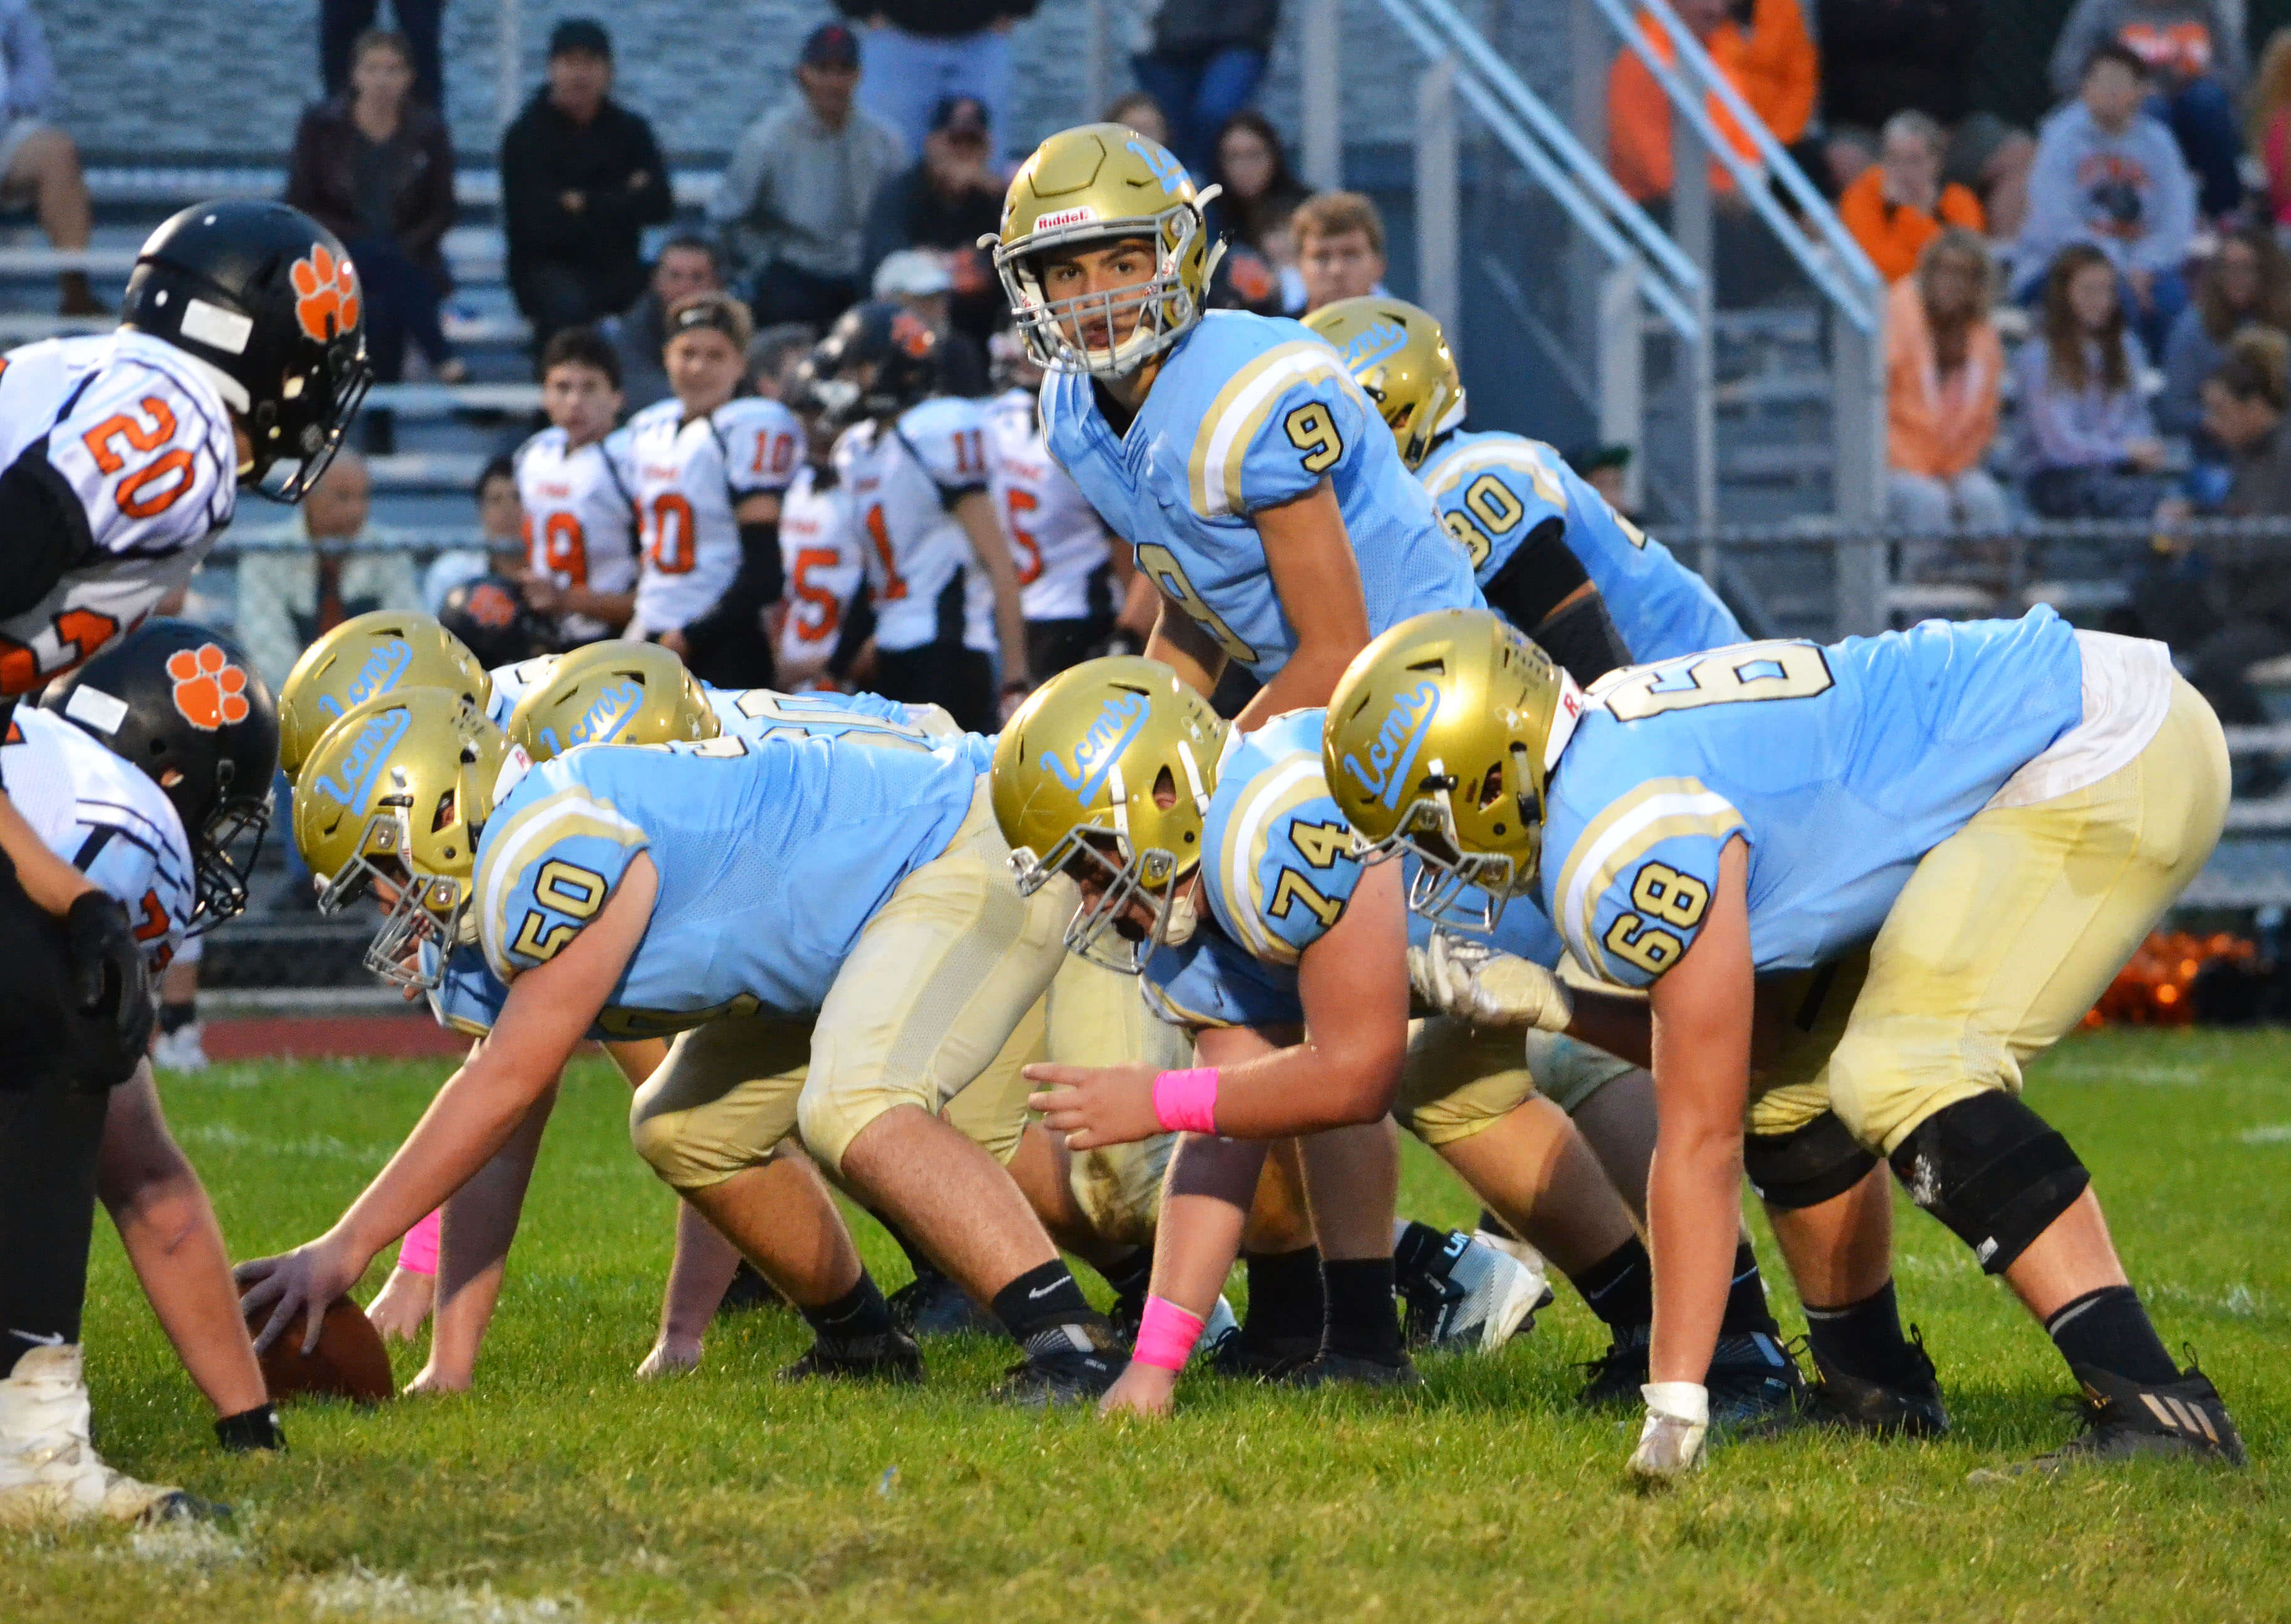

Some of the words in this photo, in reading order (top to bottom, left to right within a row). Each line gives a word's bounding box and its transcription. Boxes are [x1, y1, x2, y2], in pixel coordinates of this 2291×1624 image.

[83, 397, 196, 519] 20
[752, 429, 793, 474] 10
[950, 428, 986, 474] 11
[1285, 401, 1344, 473] 9
[793, 548, 838, 641] 5
[509, 858, 608, 962] 50
[1267, 817, 1357, 929] 74
[1602, 858, 1710, 974] 68
